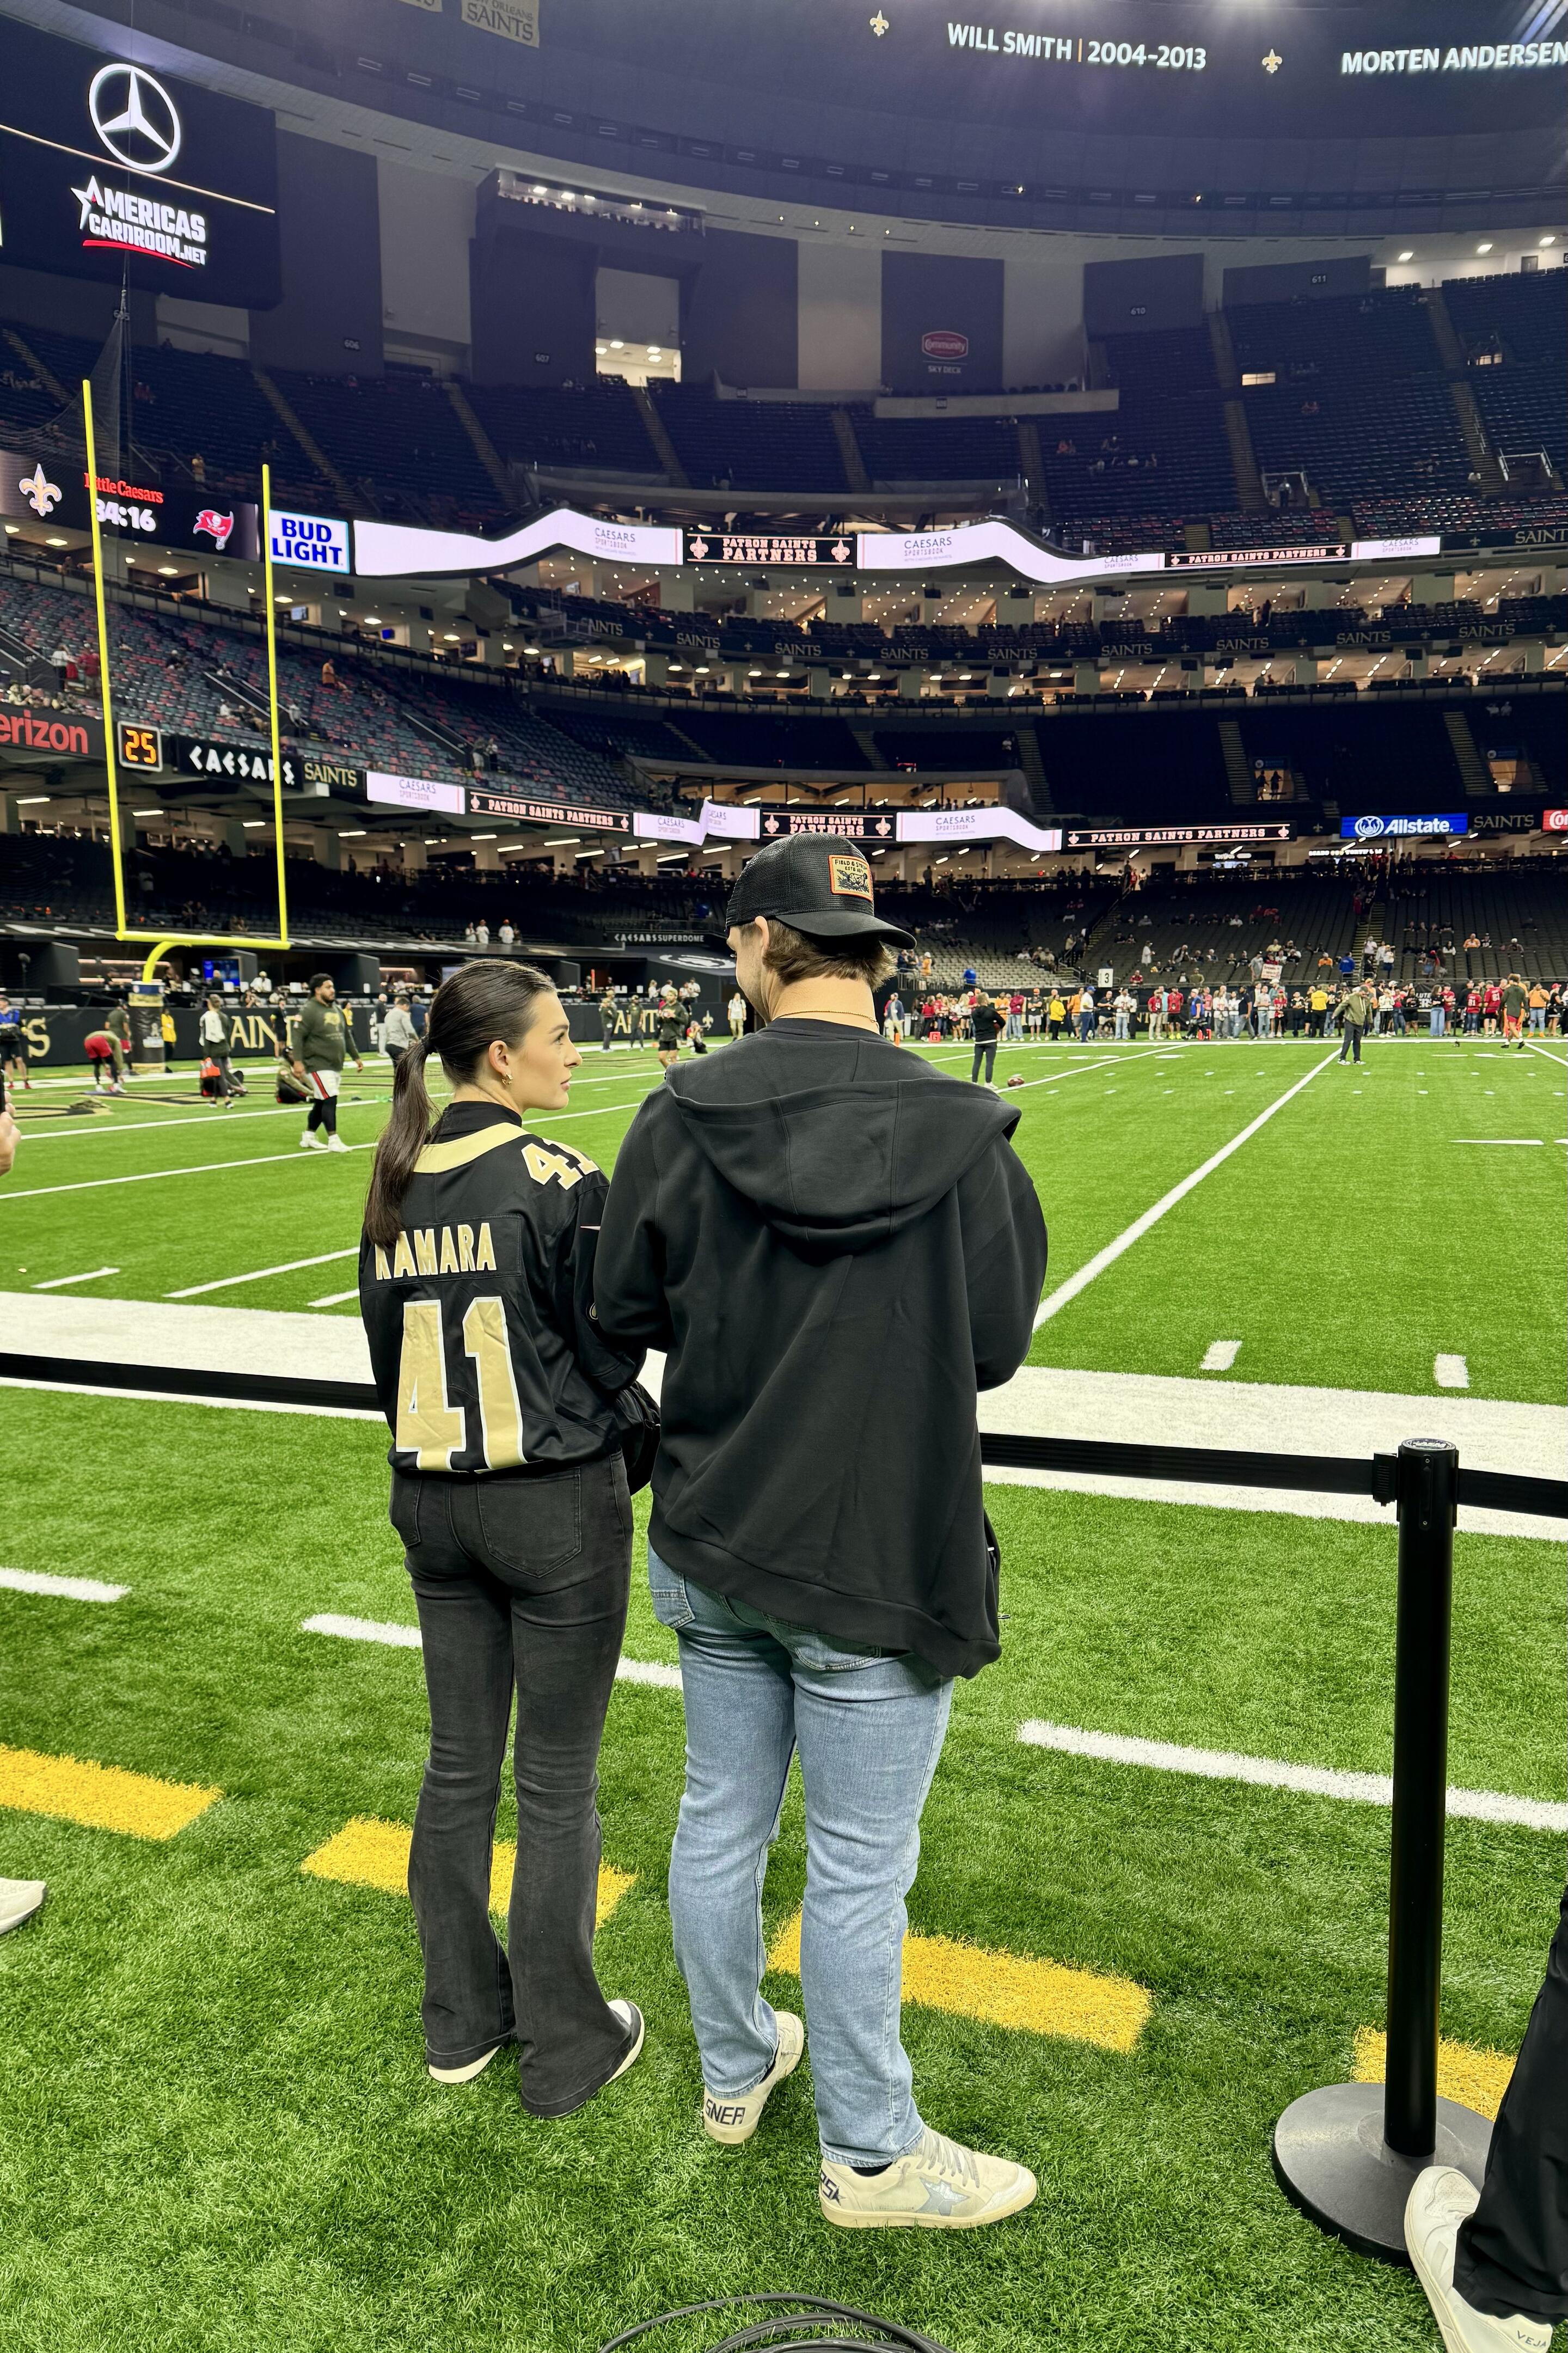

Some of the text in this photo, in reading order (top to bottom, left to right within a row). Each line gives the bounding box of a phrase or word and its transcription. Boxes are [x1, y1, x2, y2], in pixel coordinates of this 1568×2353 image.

[467, 3, 534, 41] SAINTS
[947, 22, 1207, 69] WILL SMITH 2004-2013
[1342, 41, 1568, 73] MORTEN ANDERSEN
[71, 175, 206, 243] AMERICAS
[1312, 275, 1326, 284] 611
[1131, 307, 1146, 316] 610
[925, 338, 966, 353] Community
[928, 365, 942, 373] SKY
[83, 472, 163, 504] Lttle Caesars
[281, 518, 332, 543] BUD
[595, 527, 636, 543] CAESARS
[722, 538, 817, 550] PATRON SAINTS
[904, 536, 952, 549] CAESARS
[272, 537, 343, 565] LIGHT
[722, 547, 817, 562] PARTNERS
[1189, 548, 1327, 564] PATRON SAINTS PARTNERS
[1336, 631, 1391, 644] SAINTS
[1459, 624, 1515, 638] SAINTS
[676, 632, 721, 649] SAINTS
[1216, 638, 1269, 651] SAINTS
[775, 643, 822, 657] SAINTS
[880, 647, 929, 660] SAINTS
[988, 647, 1038, 660] SAINTS
[1101, 644, 1153, 657] SAINTS
[125, 729, 157, 764] 25
[304, 762, 358, 787] SAINTS
[399, 779, 437, 794] CAESARS
[488, 799, 614, 827] PATRON SAINTS PARTNERS
[935, 815, 976, 826] CAESARS
[790, 816, 864, 826] PATRON SAINTS
[1474, 815, 1534, 828] SAINTS
[790, 824, 865, 836] PARTNERS
[1091, 828, 1265, 843] PATRON SAINTS PARTNERS
[614, 933, 657, 942] CAESARS
[1104, 972, 1110, 983] 3
[521, 1138, 599, 1190] 41
[395, 1296, 528, 1472] 41
[1517, 2330, 1546, 2347] VEJA
